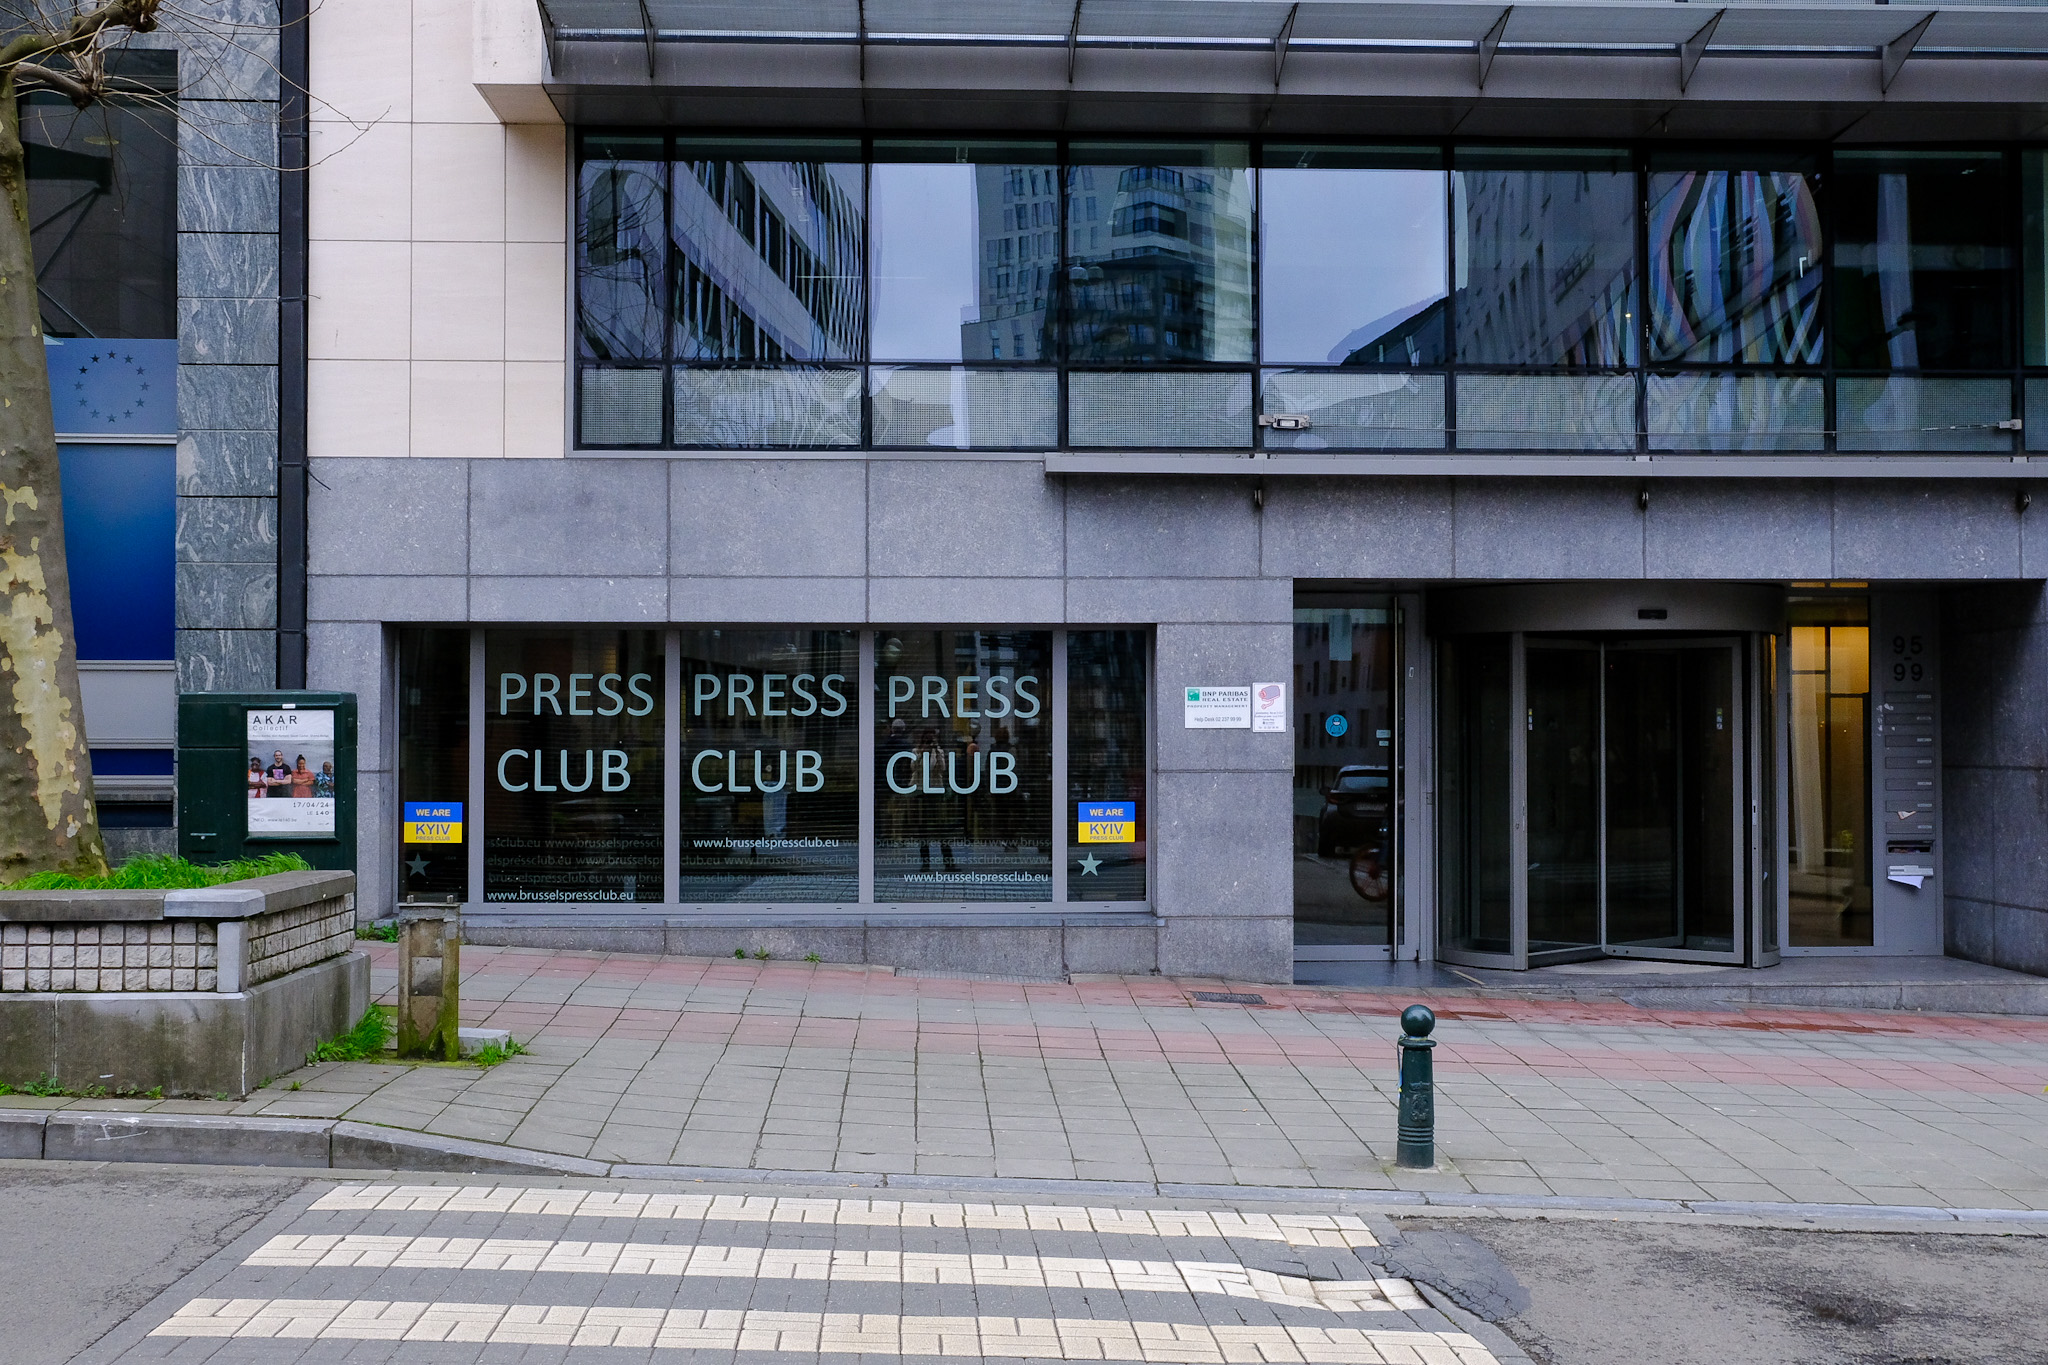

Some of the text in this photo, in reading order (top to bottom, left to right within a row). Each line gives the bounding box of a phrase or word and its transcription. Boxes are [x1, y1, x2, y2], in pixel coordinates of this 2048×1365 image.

[1893, 636, 1922, 654] 95
[1894, 663, 1923, 682] 99
[500, 672, 655, 717] PRESS
[694, 673, 847, 717] PRESS
[888, 675, 1041, 719] PRESS
[252, 715, 298, 725] AKAR
[497, 748, 632, 793] CLUB
[691, 749, 825, 793] CLUB
[886, 751, 1019, 795] CLUB
[416, 809, 451, 817] WE ARE
[1089, 808, 1124, 816] WE ARE
[416, 824, 451, 835] KYIV
[1090, 823, 1124, 835] KYIV
[693, 837, 839, 850] www.brusselspressclub.eu
[904, 871, 1049, 884] www.brusselspressclub.eu
[487, 889, 634, 902] www.brusselspressclub.eu
